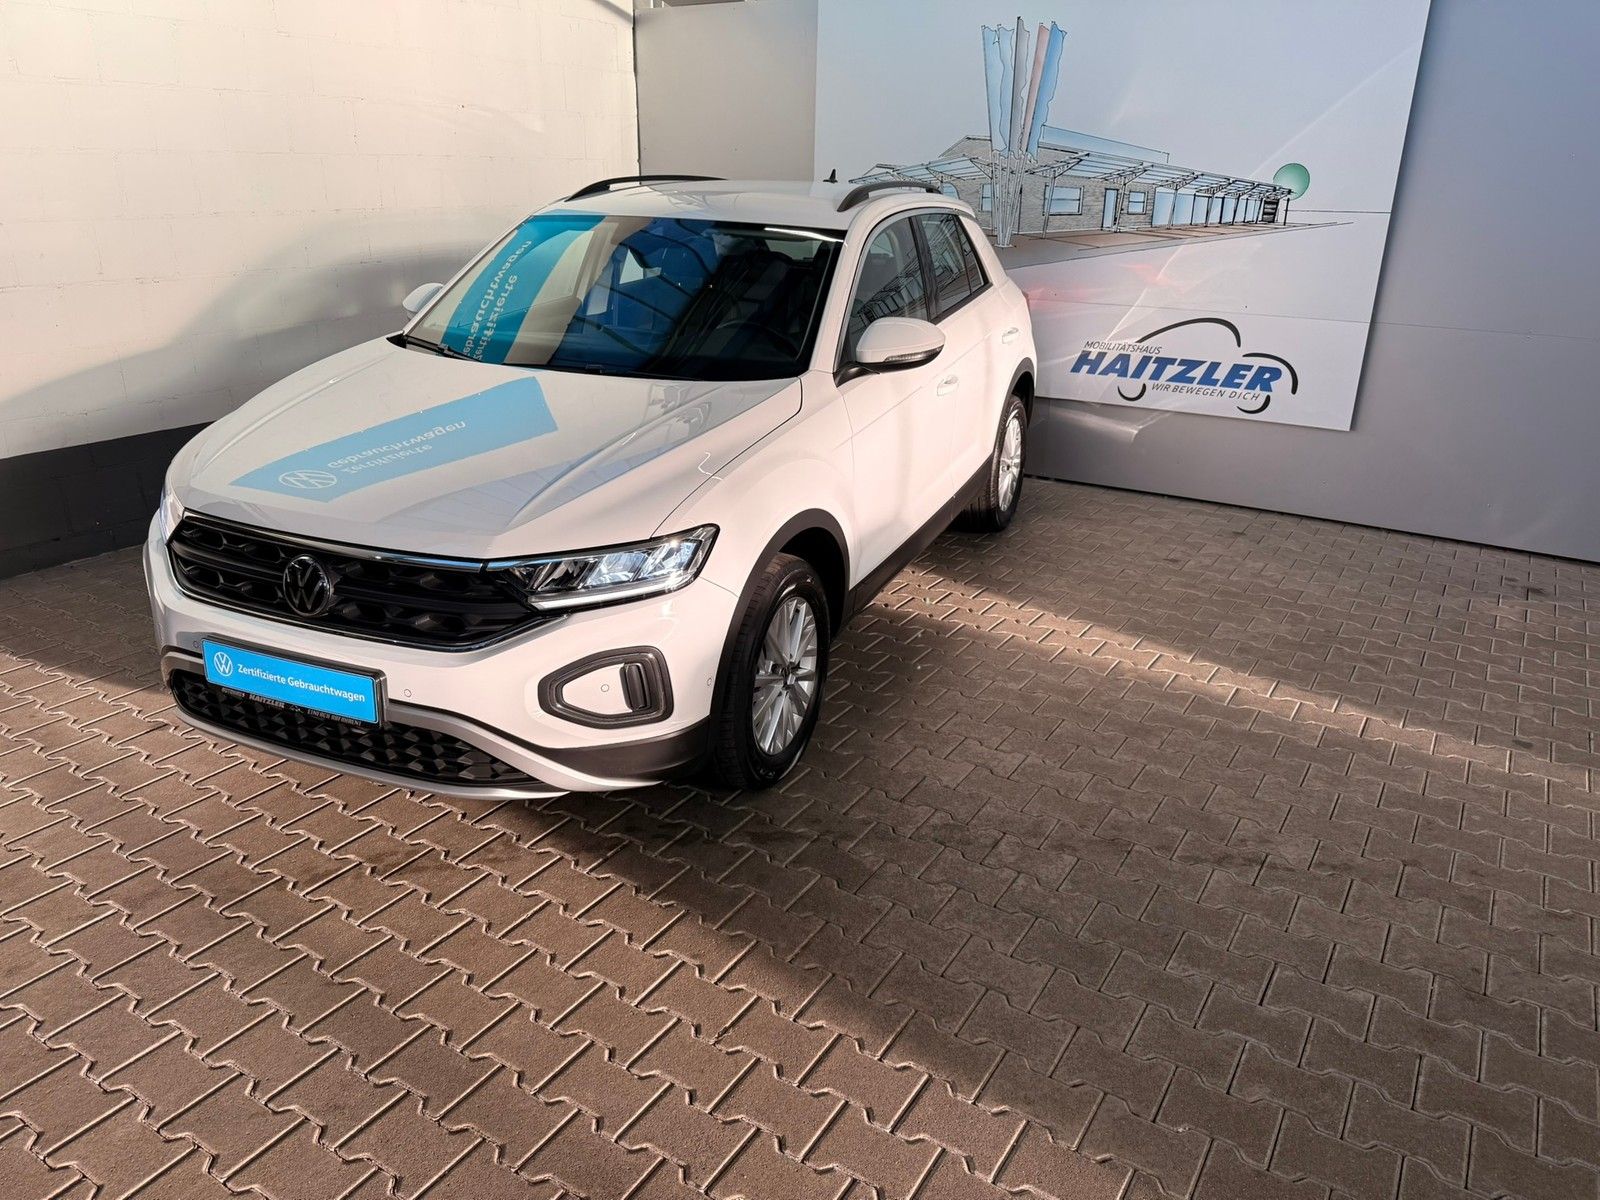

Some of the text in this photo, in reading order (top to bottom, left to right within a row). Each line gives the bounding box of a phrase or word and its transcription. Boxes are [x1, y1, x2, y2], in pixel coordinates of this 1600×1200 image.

[1084, 340, 1162, 354] MOBILITÄTSHAUS
[1070, 350, 1283, 393] HAITZLER
[1151, 382, 1261, 401] WIR BEWEGEN DICH
[237, 664, 286, 685] Zertifizierte
[287, 676, 365, 703] Gebrauchtwagen
